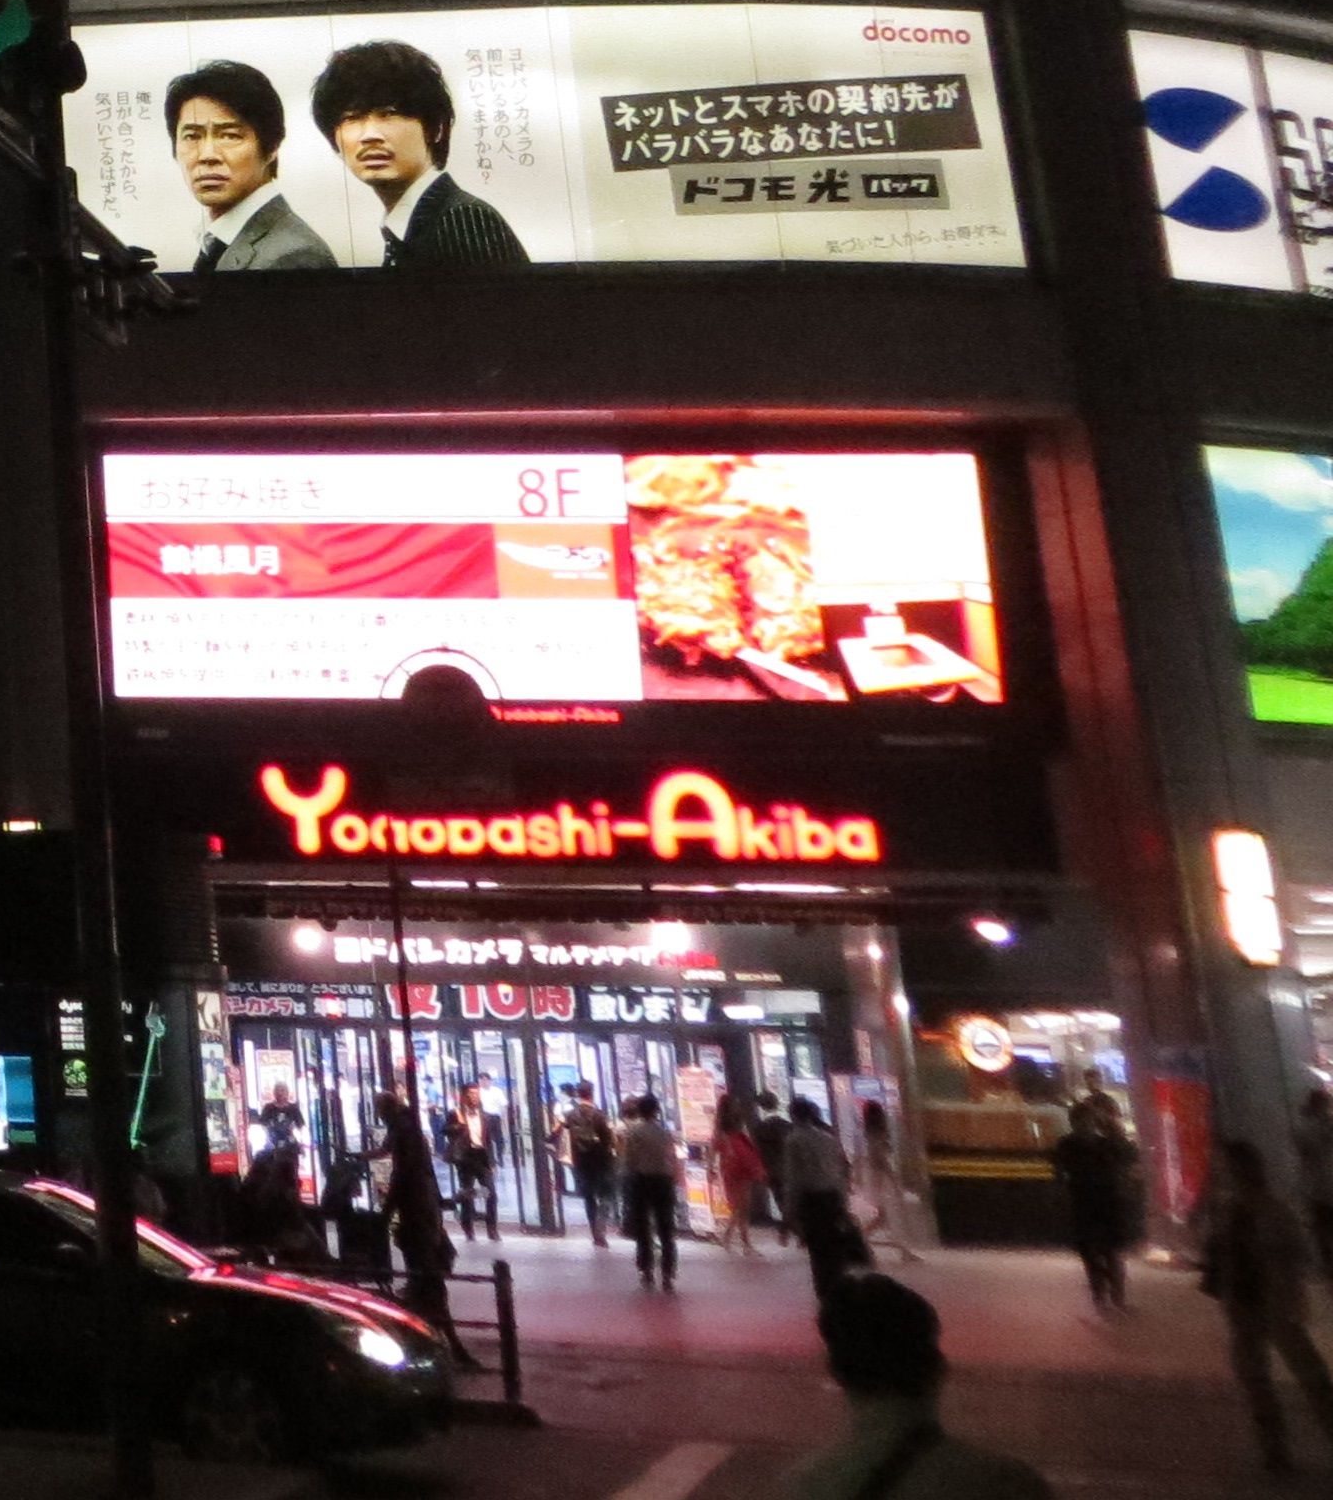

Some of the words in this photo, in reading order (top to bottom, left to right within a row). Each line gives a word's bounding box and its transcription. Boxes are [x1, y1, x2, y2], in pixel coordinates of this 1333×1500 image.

[862, 20, 972, 45] docomo
[613, 80, 961, 134] ネットとスマホの契約先が
[620, 117, 898, 164] バラバラなあなたに！
[869, 177, 930, 195] パック
[140, 476, 327, 511] お好み焼き
[518, 467, 582, 518] 8F
